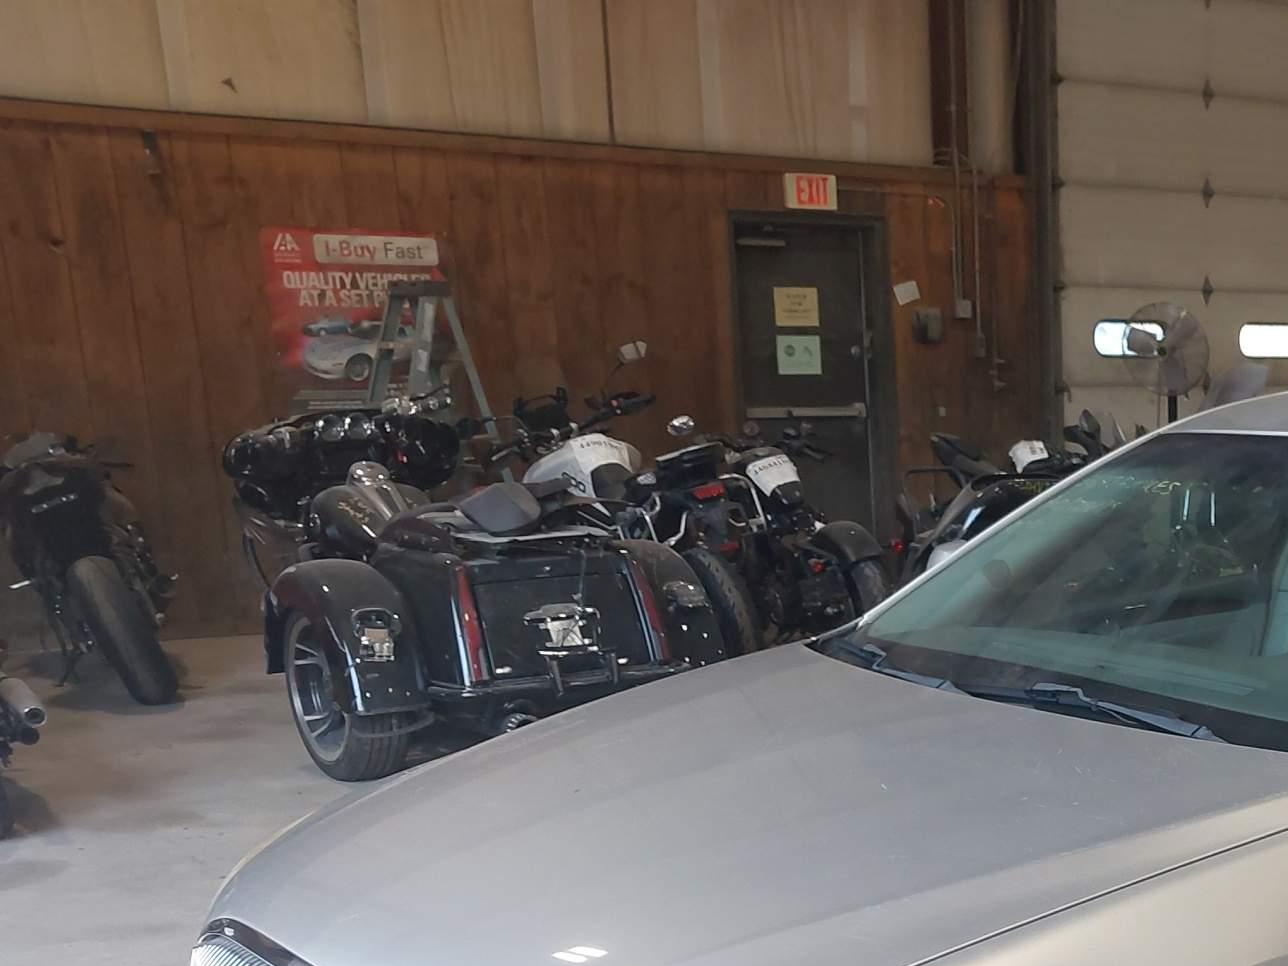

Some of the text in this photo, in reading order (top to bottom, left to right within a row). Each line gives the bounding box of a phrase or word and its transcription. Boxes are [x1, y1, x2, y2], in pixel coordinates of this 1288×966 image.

[796, 175, 829, 207] EXIT
[324, 239, 377, 261] I-Buy
[383, 241, 424, 260] Fast
[282, 270, 353, 289] QUALITY
[298, 289, 321, 307] AT
[324, 289, 337, 307] A
[339, 289, 371, 308] SET
